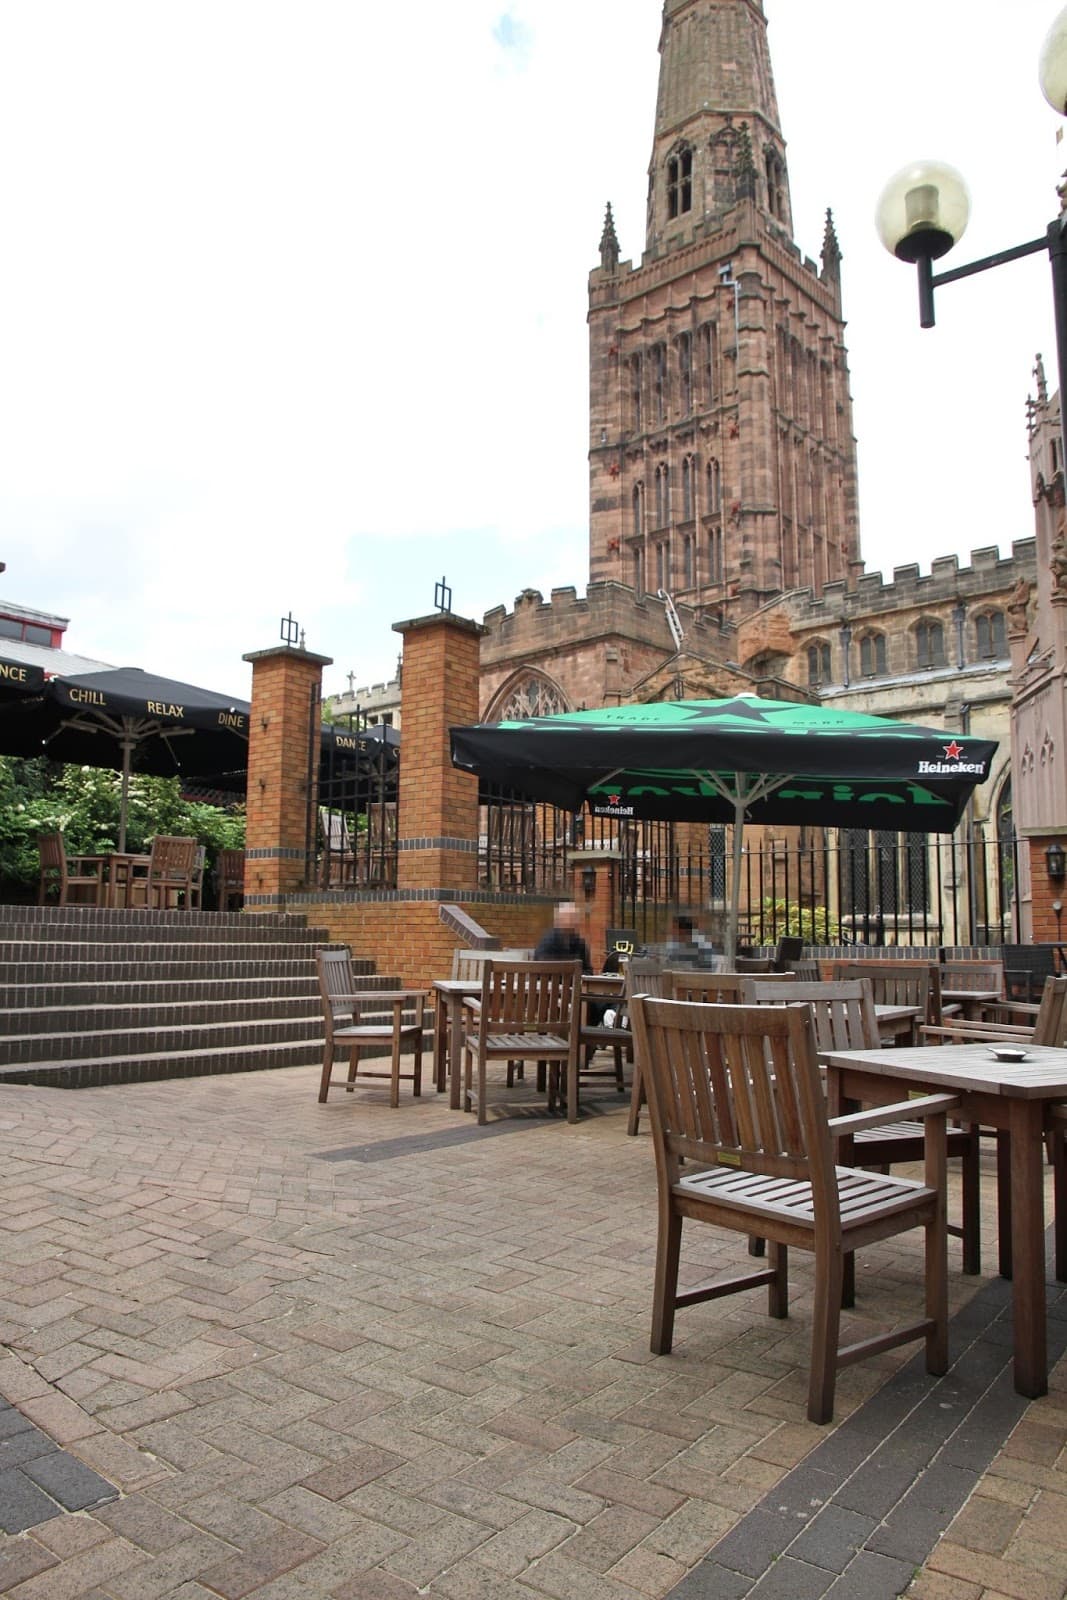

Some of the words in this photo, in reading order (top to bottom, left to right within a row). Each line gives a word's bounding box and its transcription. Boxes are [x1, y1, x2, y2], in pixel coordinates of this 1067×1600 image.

[69, 688, 107, 706] CHILL
[147, 700, 184, 718] RELAX
[218, 712, 245, 728] DINE
[918, 761, 985, 775] Heineken
